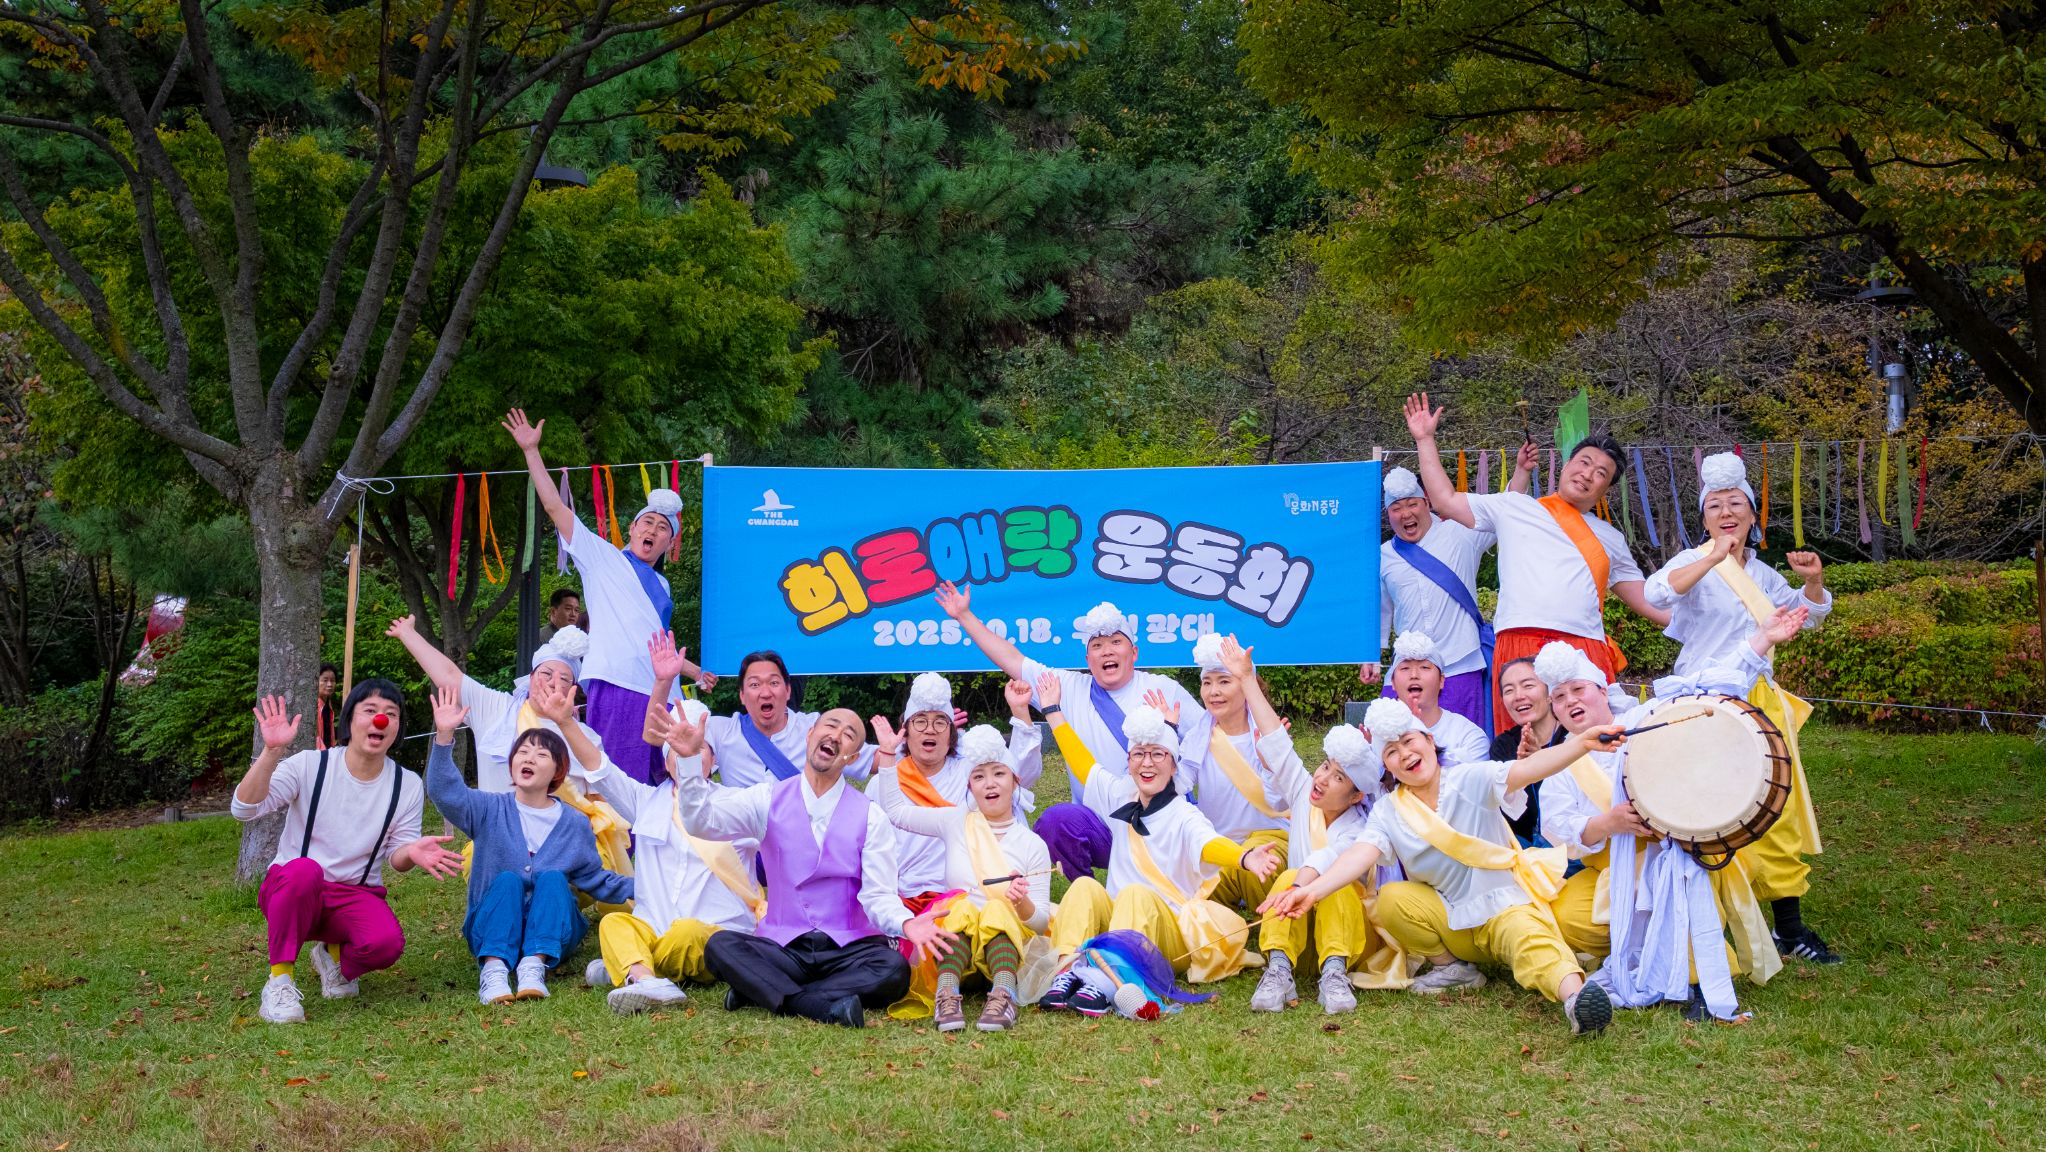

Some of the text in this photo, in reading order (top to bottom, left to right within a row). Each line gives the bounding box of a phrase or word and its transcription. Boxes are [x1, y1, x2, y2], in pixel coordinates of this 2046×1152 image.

[747, 518, 799, 527] GWANGDAE
[778, 505, 1314, 636] 희로애락 운동회
[873, 617, 1062, 647] 2025.0.18.
[1146, 612, 1215, 643] 광대
